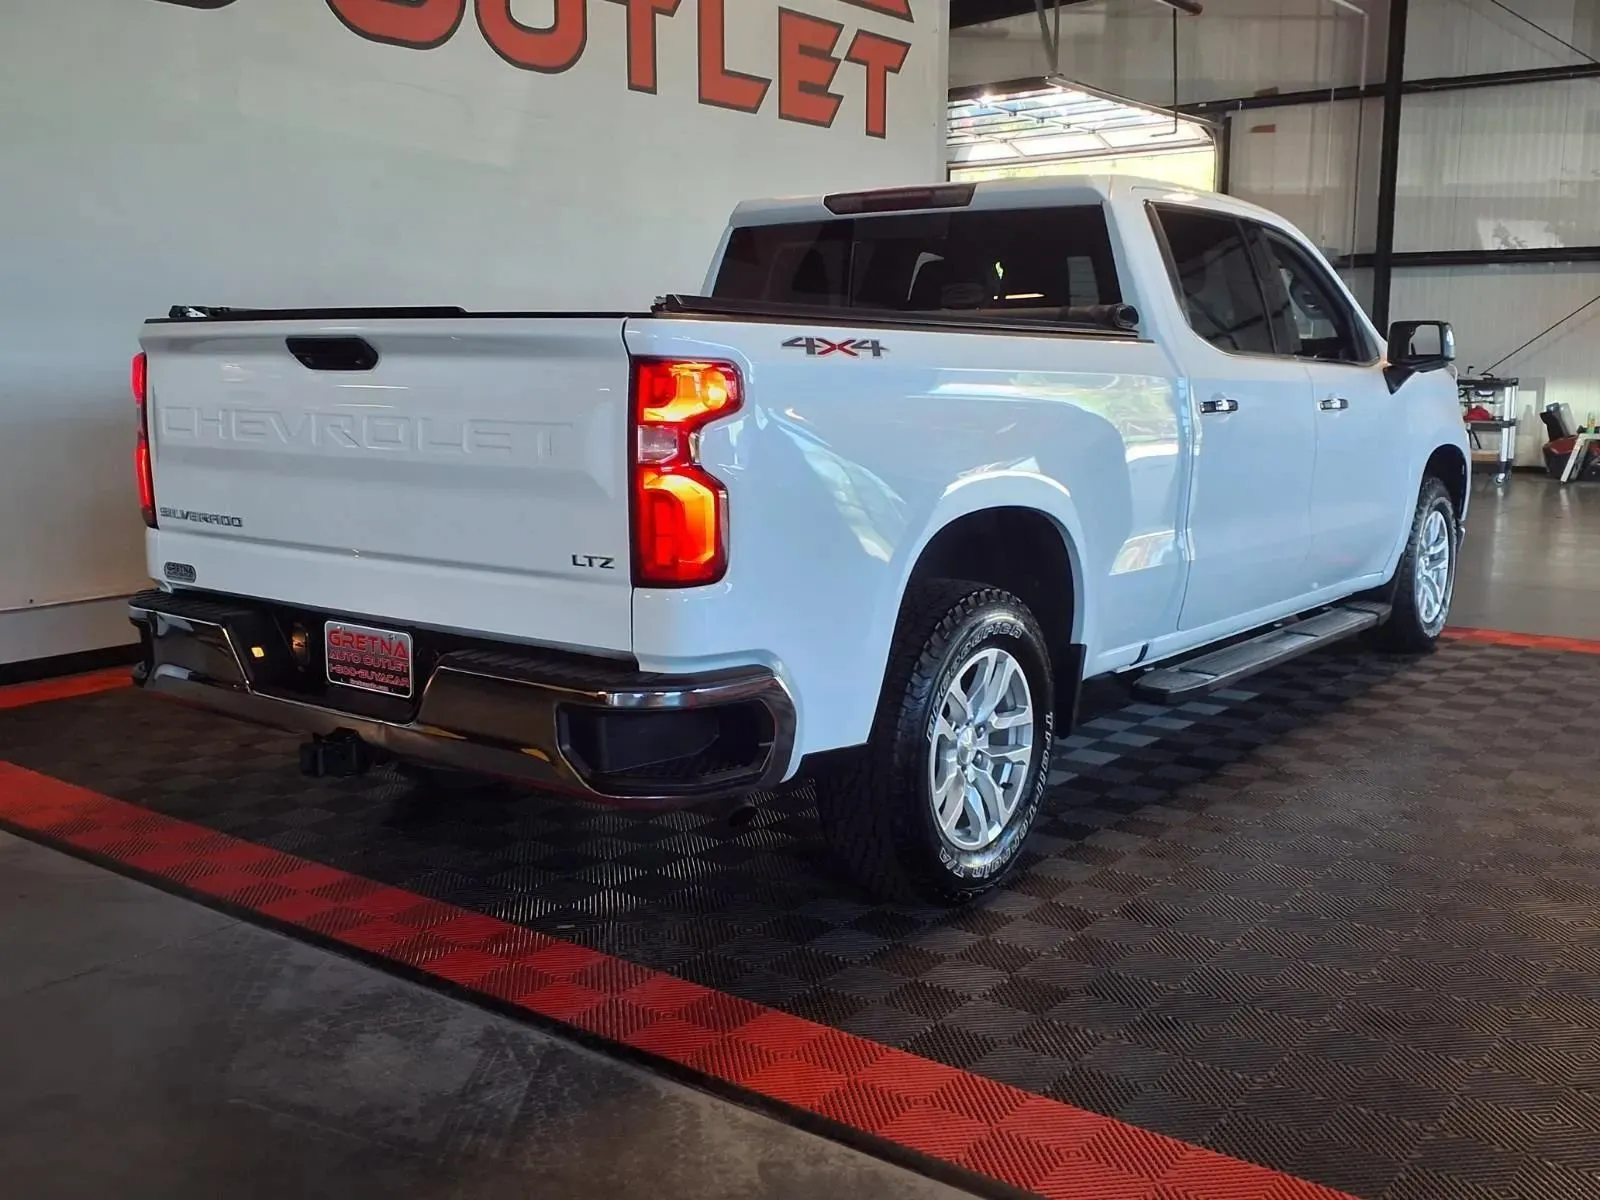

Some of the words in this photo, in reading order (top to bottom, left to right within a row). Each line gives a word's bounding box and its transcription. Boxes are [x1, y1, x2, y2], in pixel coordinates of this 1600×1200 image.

[160, 406, 574, 460] CHEVROLET
[160, 507, 243, 527] SILVERADO
[571, 554, 615, 569] LTZ
[328, 629, 409, 658] GRETNA
[329, 649, 361, 664] AUTO
[363, 656, 409, 673] OUTLET
